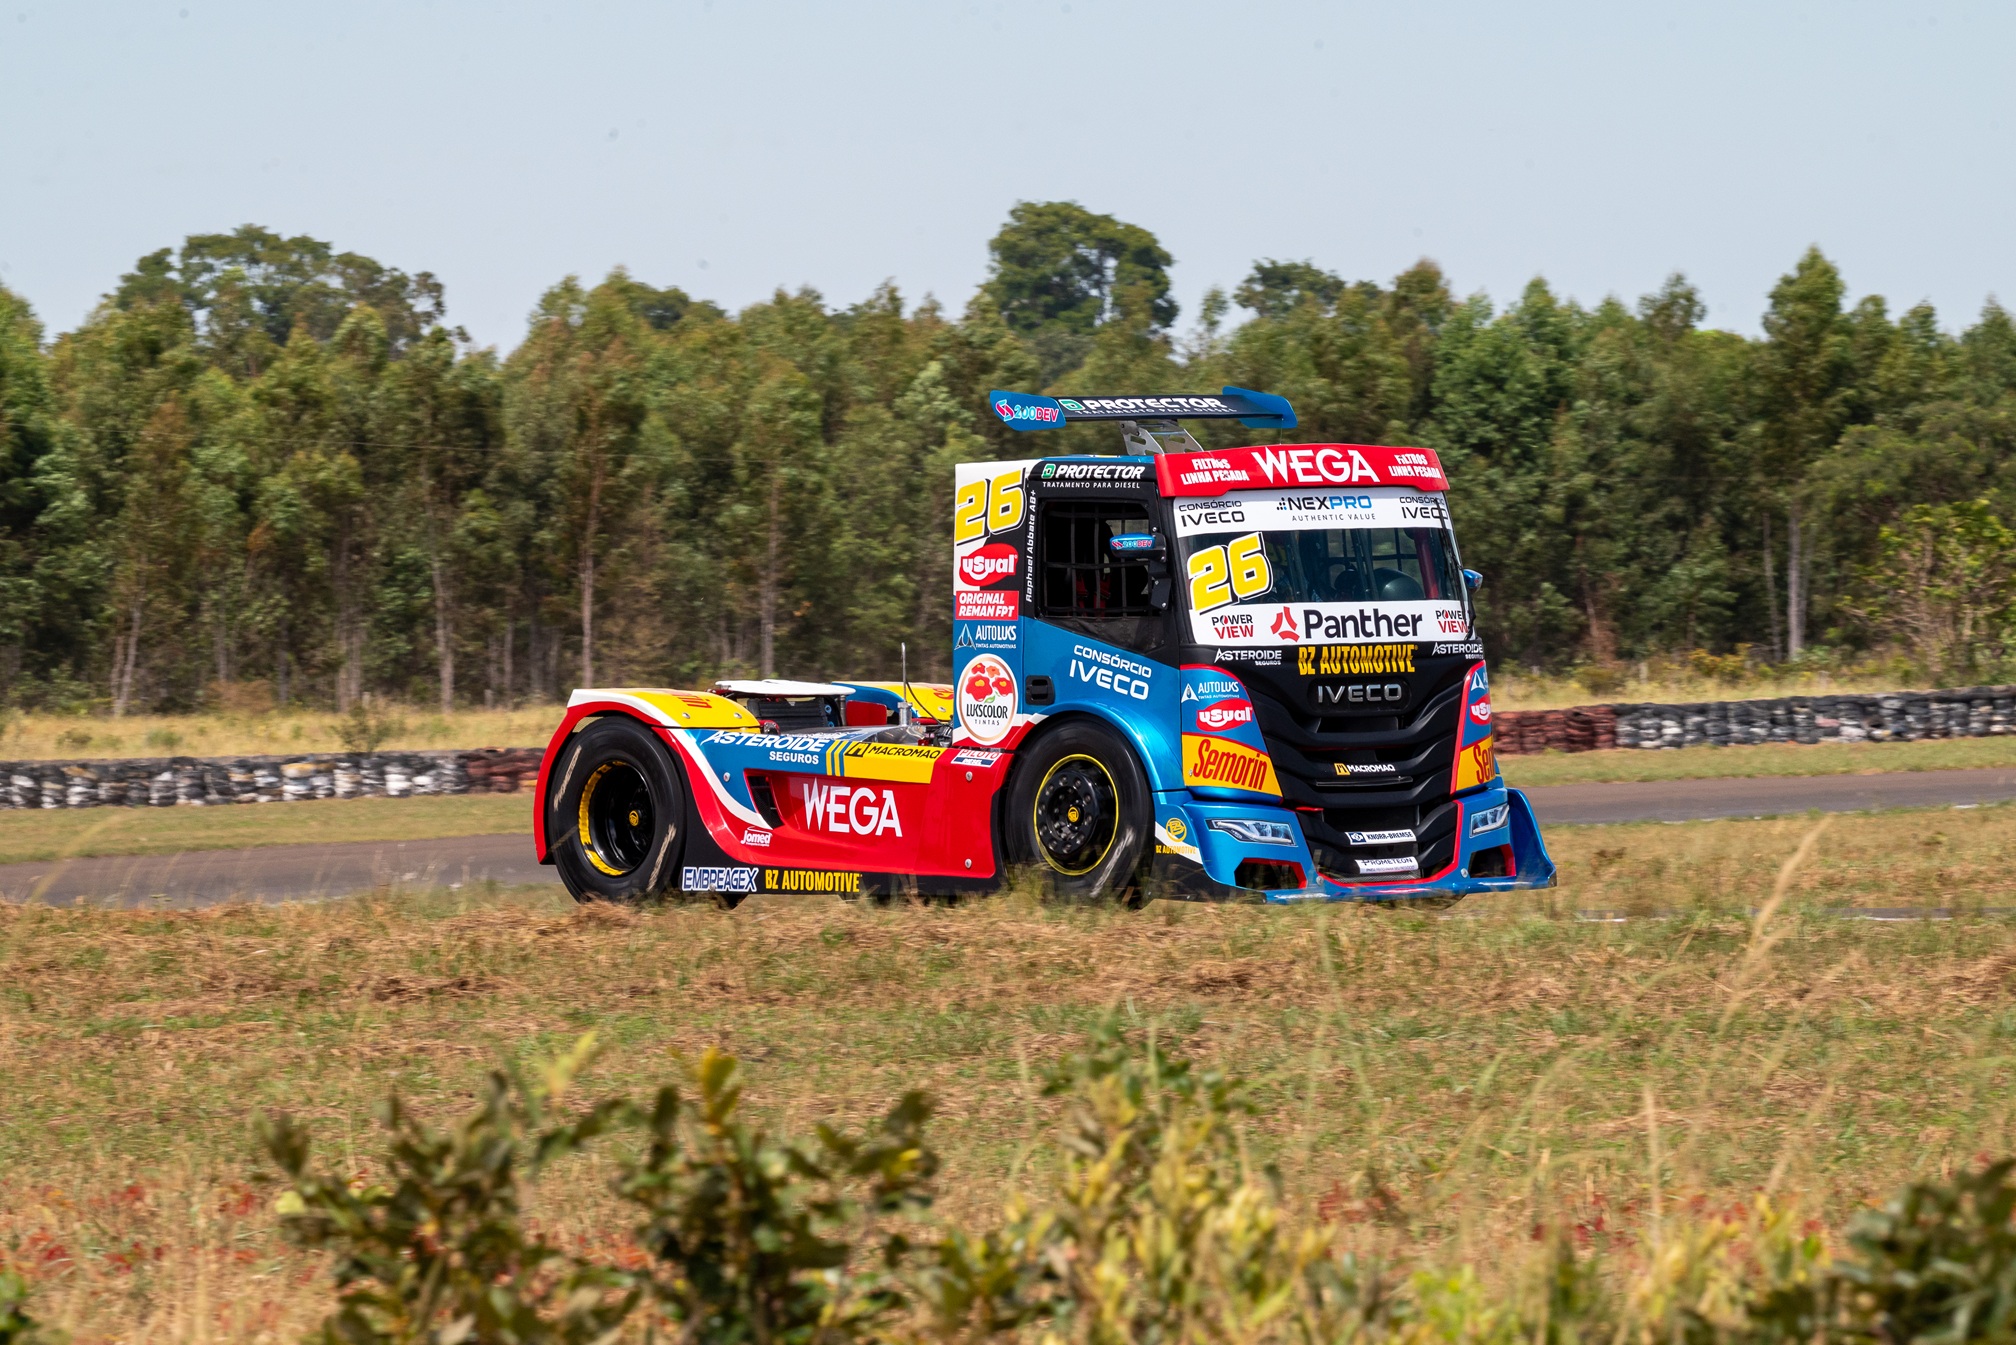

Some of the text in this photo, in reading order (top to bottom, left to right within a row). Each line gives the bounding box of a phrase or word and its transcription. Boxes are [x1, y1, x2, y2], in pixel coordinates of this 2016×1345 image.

[1083, 398, 1227, 410] PROTECTOR
[1191, 458, 1231, 471] FILTROS
[1252, 447, 1380, 483] WEGA
[1394, 453, 1428, 465] FILTROS
[1055, 465, 1145, 479] PROTECTOR
[1180, 469, 1250, 486] LINHA PESADA
[1388, 465, 1442, 479] LINHA PESADA
[1042, 481, 1090, 489] TRATAMENTO
[954, 468, 1026, 546] 26
[1179, 500, 1242, 512] CONSÓRCIO
[1288, 495, 1372, 511] NEXPRO
[1181, 511, 1245, 527] IVECO
[1292, 513, 1376, 522] AUTHENTIC VALUE
[1025, 489, 1037, 602] Raphael Abbate AB+
[962, 554, 1015, 580] usual
[1187, 532, 1273, 615] 26
[959, 593, 1005, 605] ORIGINAL
[958, 606, 1015, 617] REMAN FPT
[1435, 609, 1464, 620] POWE
[1211, 614, 1254, 626] POWER
[1304, 608, 1423, 639] Panther
[1438, 620, 1469, 633] VIEW
[1214, 625, 1254, 639] VIEW
[1214, 648, 1282, 663] ASTEROIDE
[1432, 642, 1483, 656] ASTEROIDE
[1073, 644, 1152, 679] CONSÓRCIO
[1298, 644, 1415, 675] BZ AUTOMOTIVE
[1069, 659, 1149, 700] IVECO
[1317, 683, 1402, 704] IVECO
[966, 704, 1008, 719] LUKSCOLOR
[1199, 706, 1251, 728] usual
[700, 731, 830, 752] ASTEROIDE
[769, 750, 819, 765] SEGUROS
[868, 745, 941, 760] MACROMAQ
[960, 749, 1000, 759] PILOTO
[1193, 739, 1267, 791] Semorin
[1347, 764, 1396, 772] MACROMAQ
[803, 777, 903, 838] WEGA
[1162, 845, 1196, 854] AUTOMOTIVE
[765, 870, 860, 892] BZ AUTOMOTIVE
